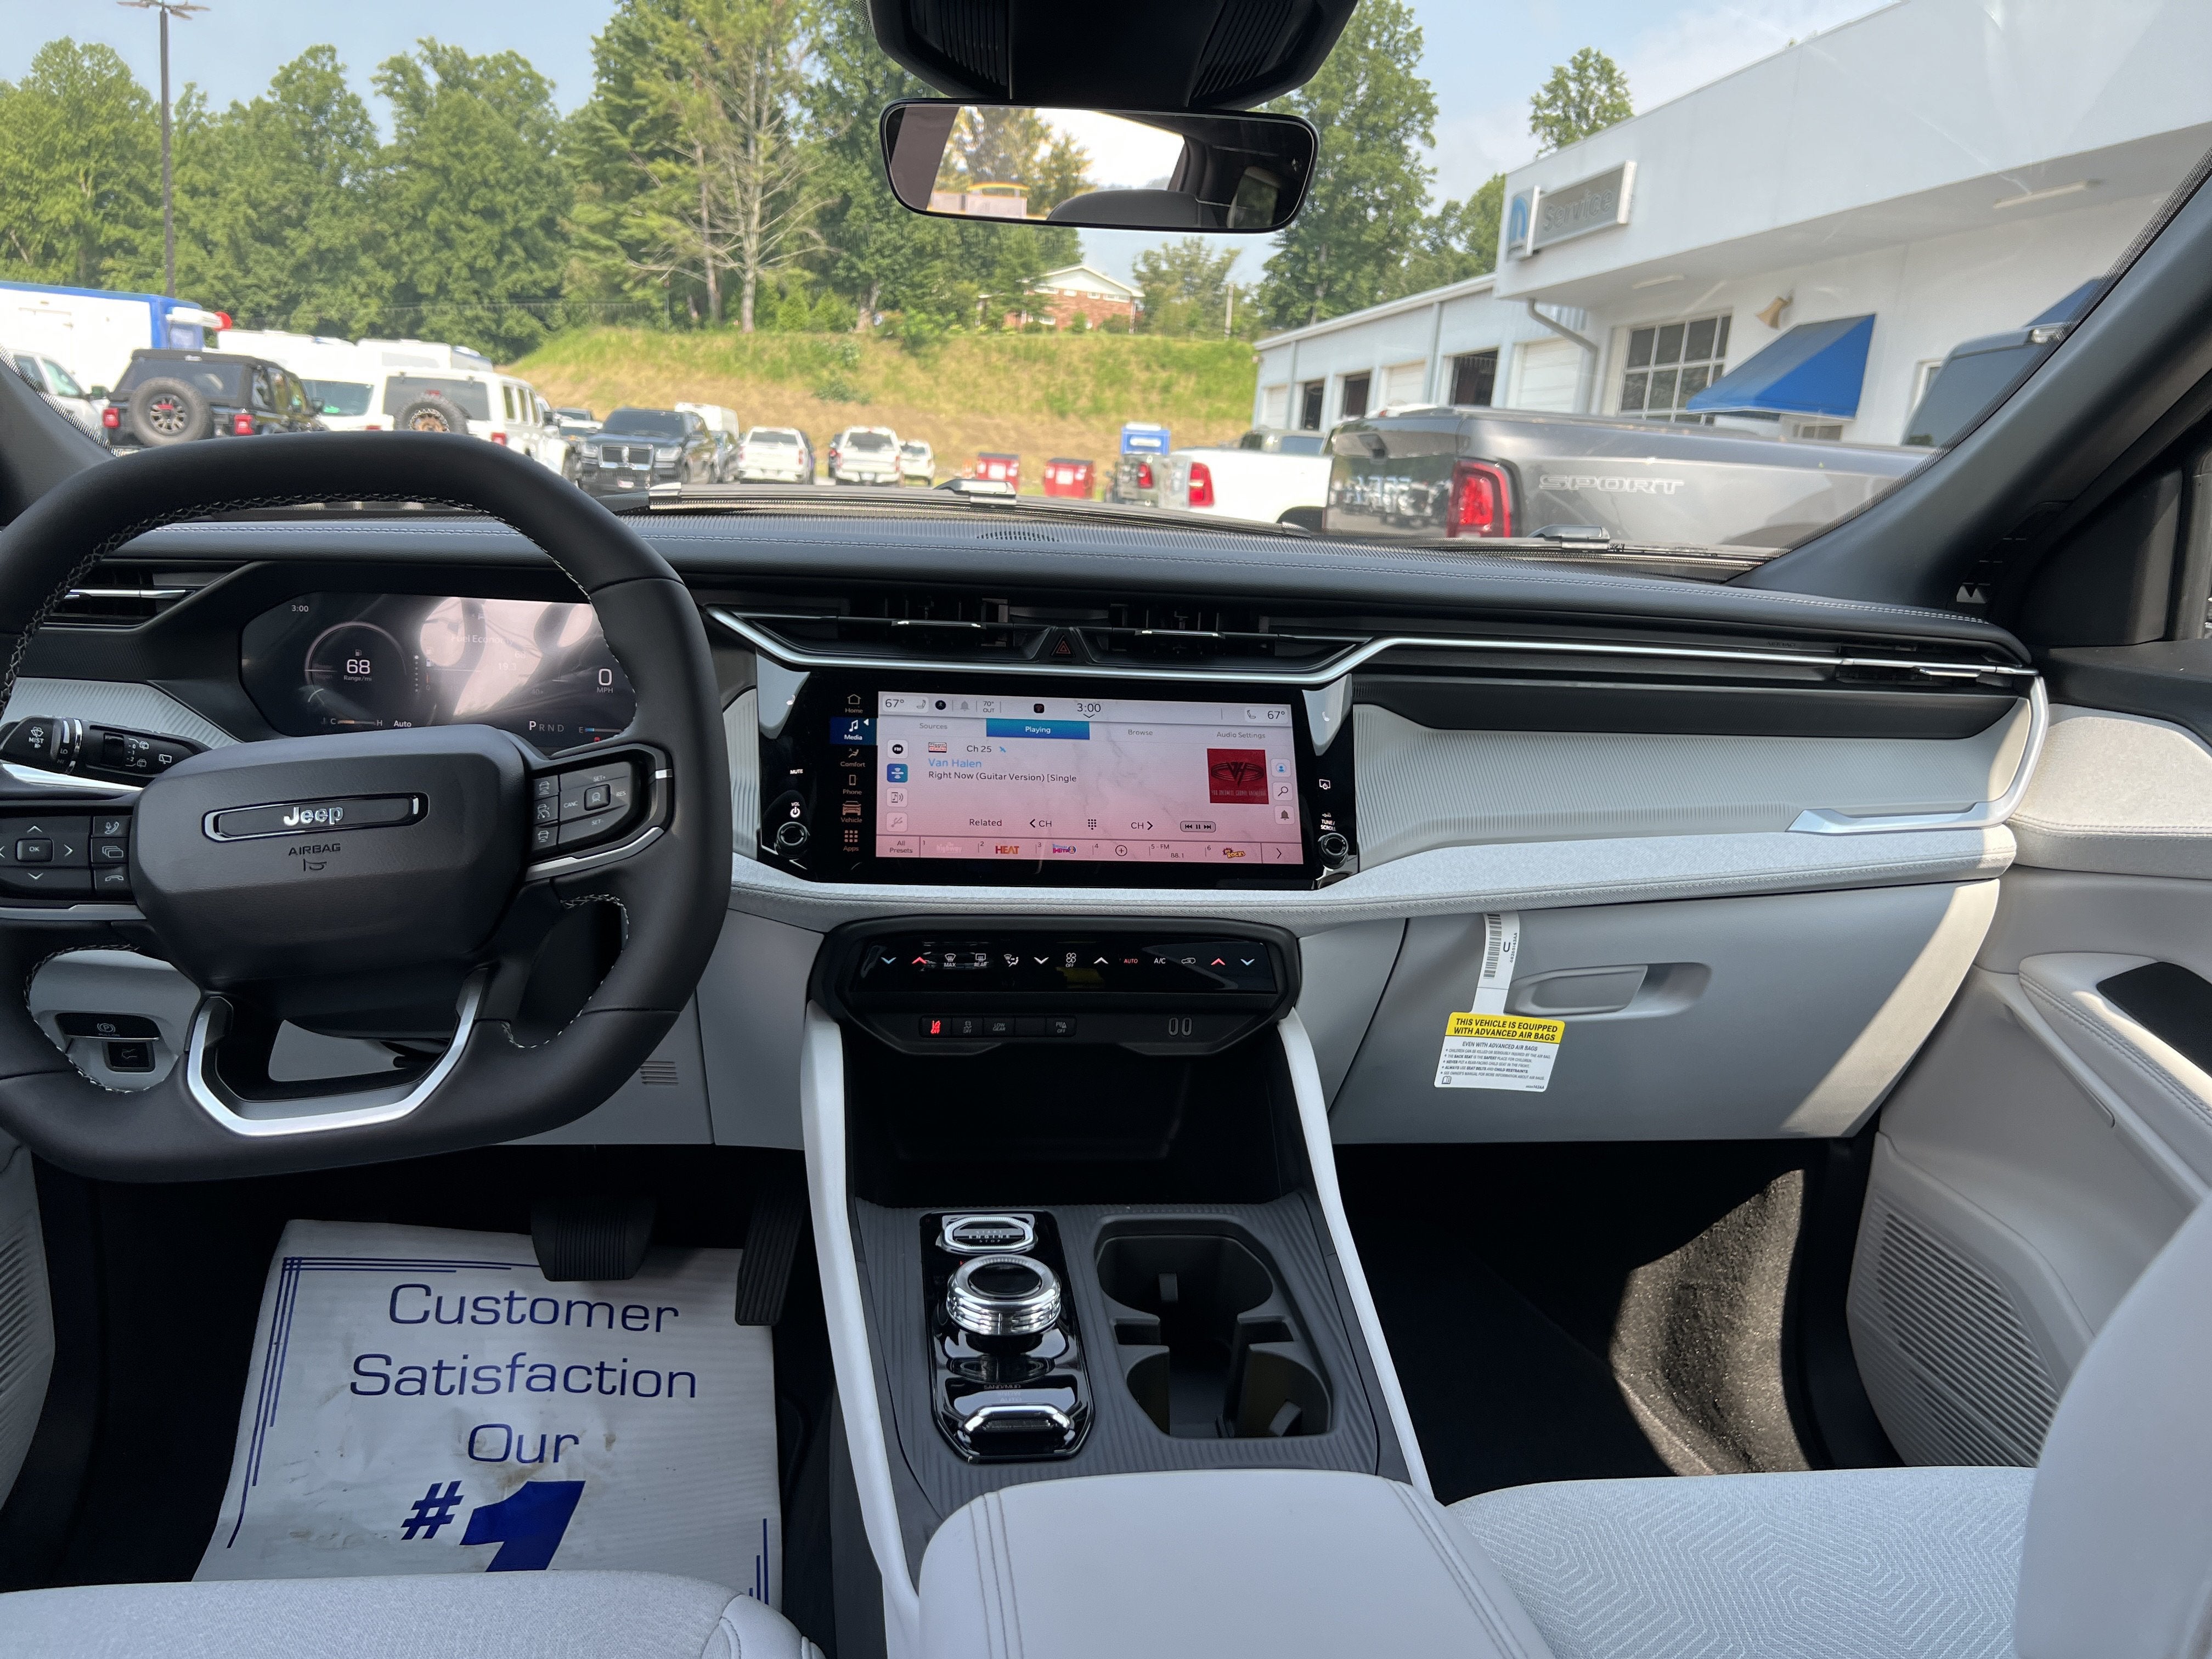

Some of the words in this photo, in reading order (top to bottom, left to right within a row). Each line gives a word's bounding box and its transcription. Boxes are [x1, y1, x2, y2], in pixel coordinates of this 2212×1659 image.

[1543, 189, 1613, 233] Service
[1539, 475, 1684, 495] SPORT
[347, 659, 371, 674] 68
[599, 668, 613, 686] 0
[885, 699, 904, 708] 67°
[1077, 703, 1101, 713] 3:00
[1267, 710, 1285, 720] 67°
[529, 720, 537, 730] P
[1025, 726, 1051, 735] Playing
[928, 759, 948, 768] Van
[951, 759, 982, 768] Halen
[928, 771, 952, 781] Right
[975, 771, 1006, 782] (Guitar
[1008, 772, 1045, 783] Version)
[1047, 774, 1077, 784] [Single
[283, 806, 344, 826] Jeep
[969, 818, 1002, 827] Related
[288, 843, 341, 856] AIRBAG
[995, 845, 1019, 854] HEAT
[1475, 1019, 1506, 1028] VEHICLE
[1517, 1022, 1558, 1032] EQUIPPED
[1474, 1028, 1517, 1037] ADVANCED
[1534, 1032, 1555, 1041] BAGS
[389, 1283, 679, 1333] Customer
[350, 1351, 697, 1398] Satisfaction
[467, 1423, 580, 1465] Our
[401, 1480, 586, 1573] #1
